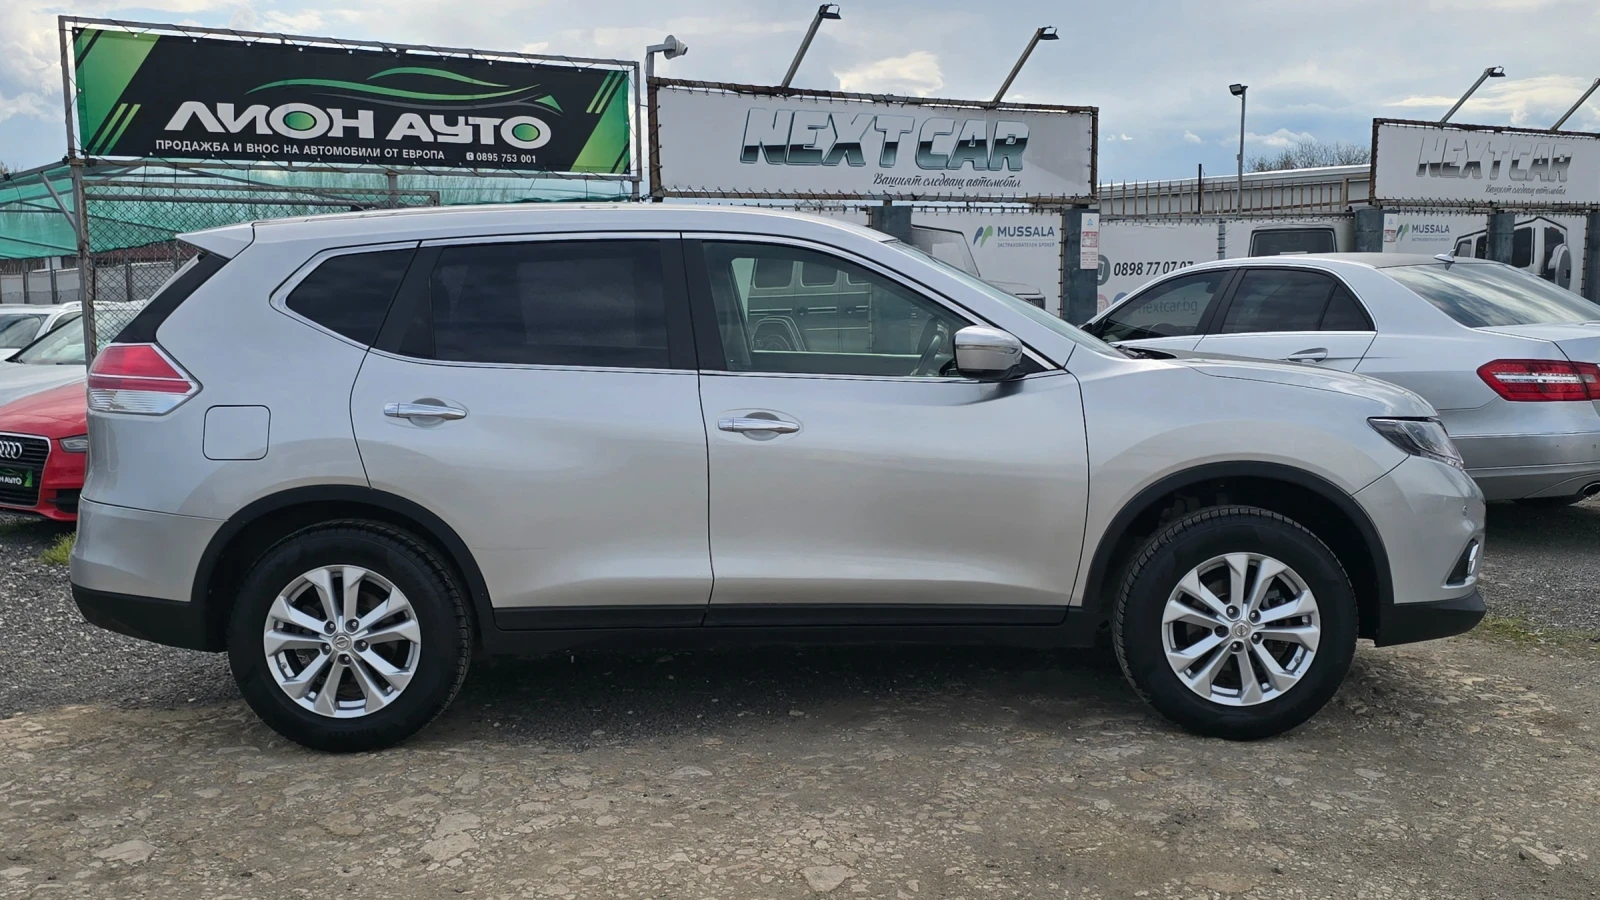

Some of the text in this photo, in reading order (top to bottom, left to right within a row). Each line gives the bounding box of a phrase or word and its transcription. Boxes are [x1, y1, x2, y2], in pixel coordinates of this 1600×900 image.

[164, 101, 551, 149] ЛИОН АУТО
[740, 107, 1030, 172] NEXTCAR
[156, 140, 445, 160] ПРОДАЖБА И ВНОС НА АВТОМОБИЛИ ОТ ЕВРОПА
[476, 152, 536, 163] 0895 753 001
[1416, 136, 1573, 182] NEXTCAR
[873, 172, 1021, 189] Вашият следващ автомобил
[997, 226, 1055, 237] MUSSALA
[1412, 224, 1450, 233] MUSSALA
[1113, 262, 1144, 276] 0898
[1146, 262, 1160, 275] 77
[1162, 261, 1177, 274] 07
